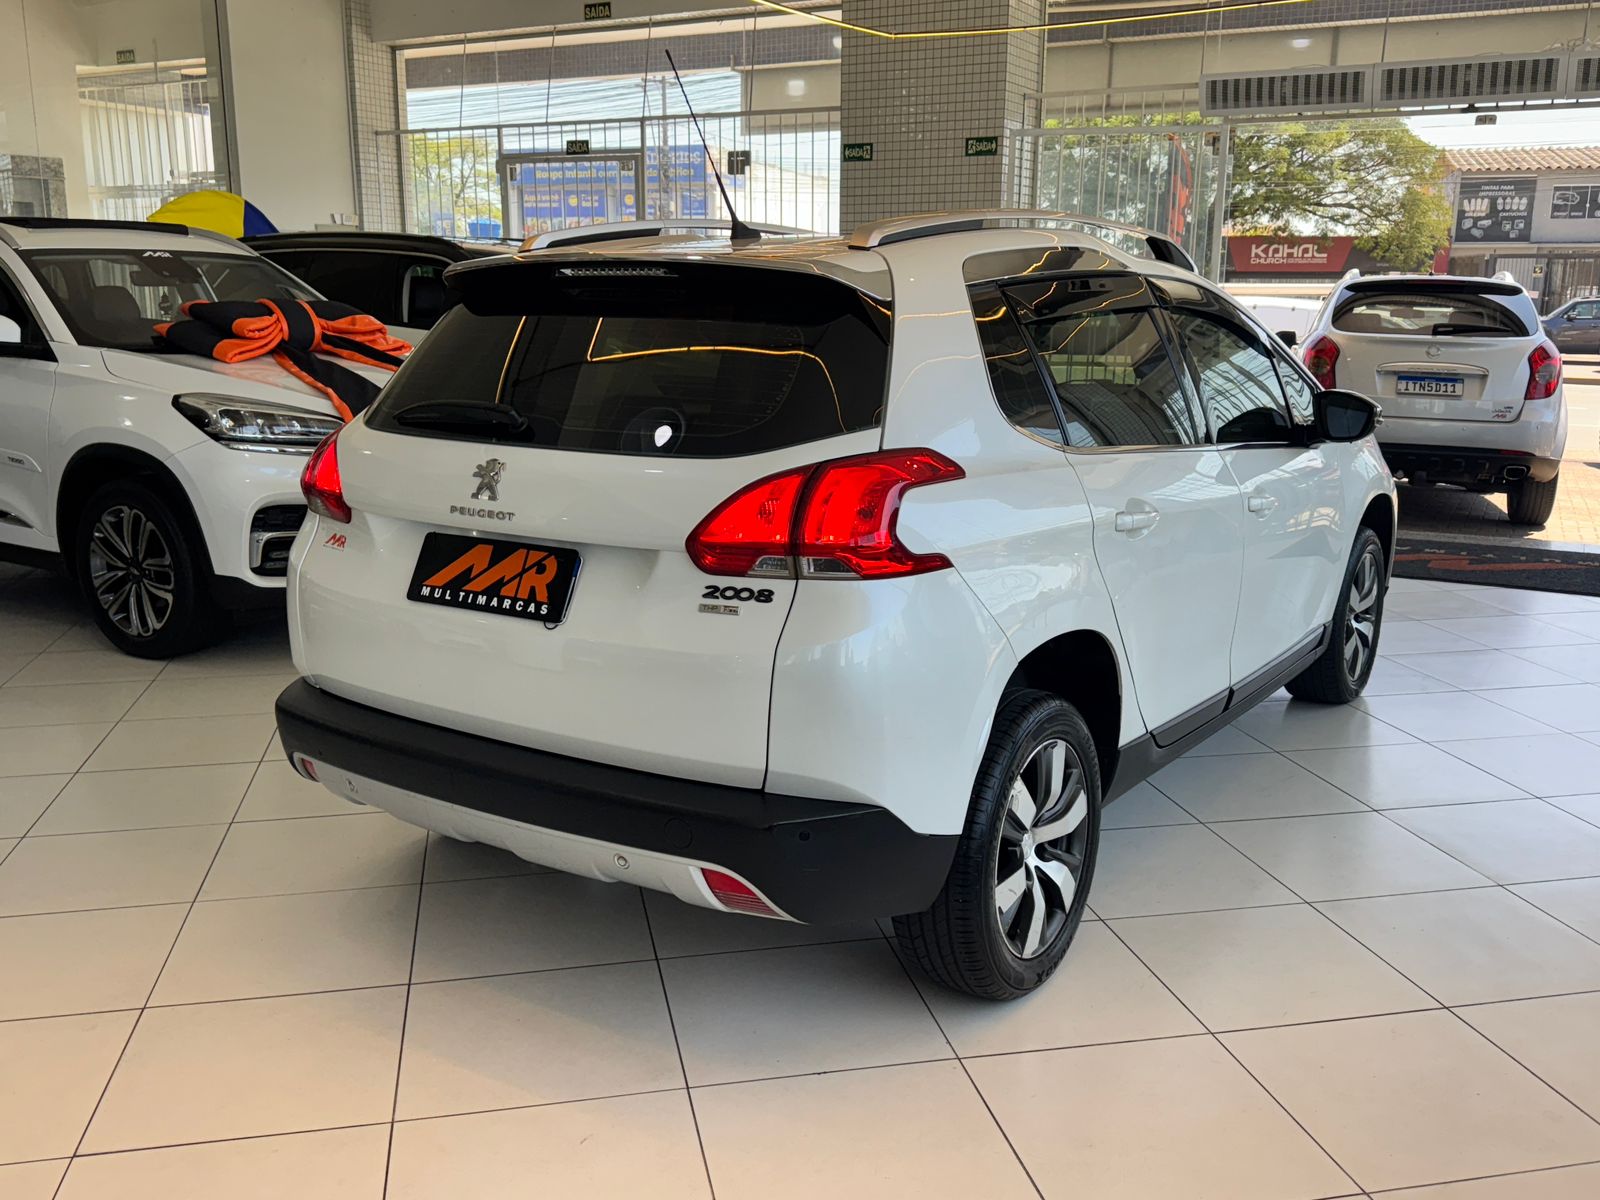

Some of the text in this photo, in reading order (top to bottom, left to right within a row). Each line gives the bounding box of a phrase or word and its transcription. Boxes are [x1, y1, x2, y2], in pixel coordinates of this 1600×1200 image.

[585, 3, 611, 19] SAÍDA
[1403, 381, 1457, 394] ITN5D11
[449, 505, 516, 522] PEUGEOT
[420, 586, 549, 616] MULTIMARCAS
[701, 584, 775, 604] 2008
